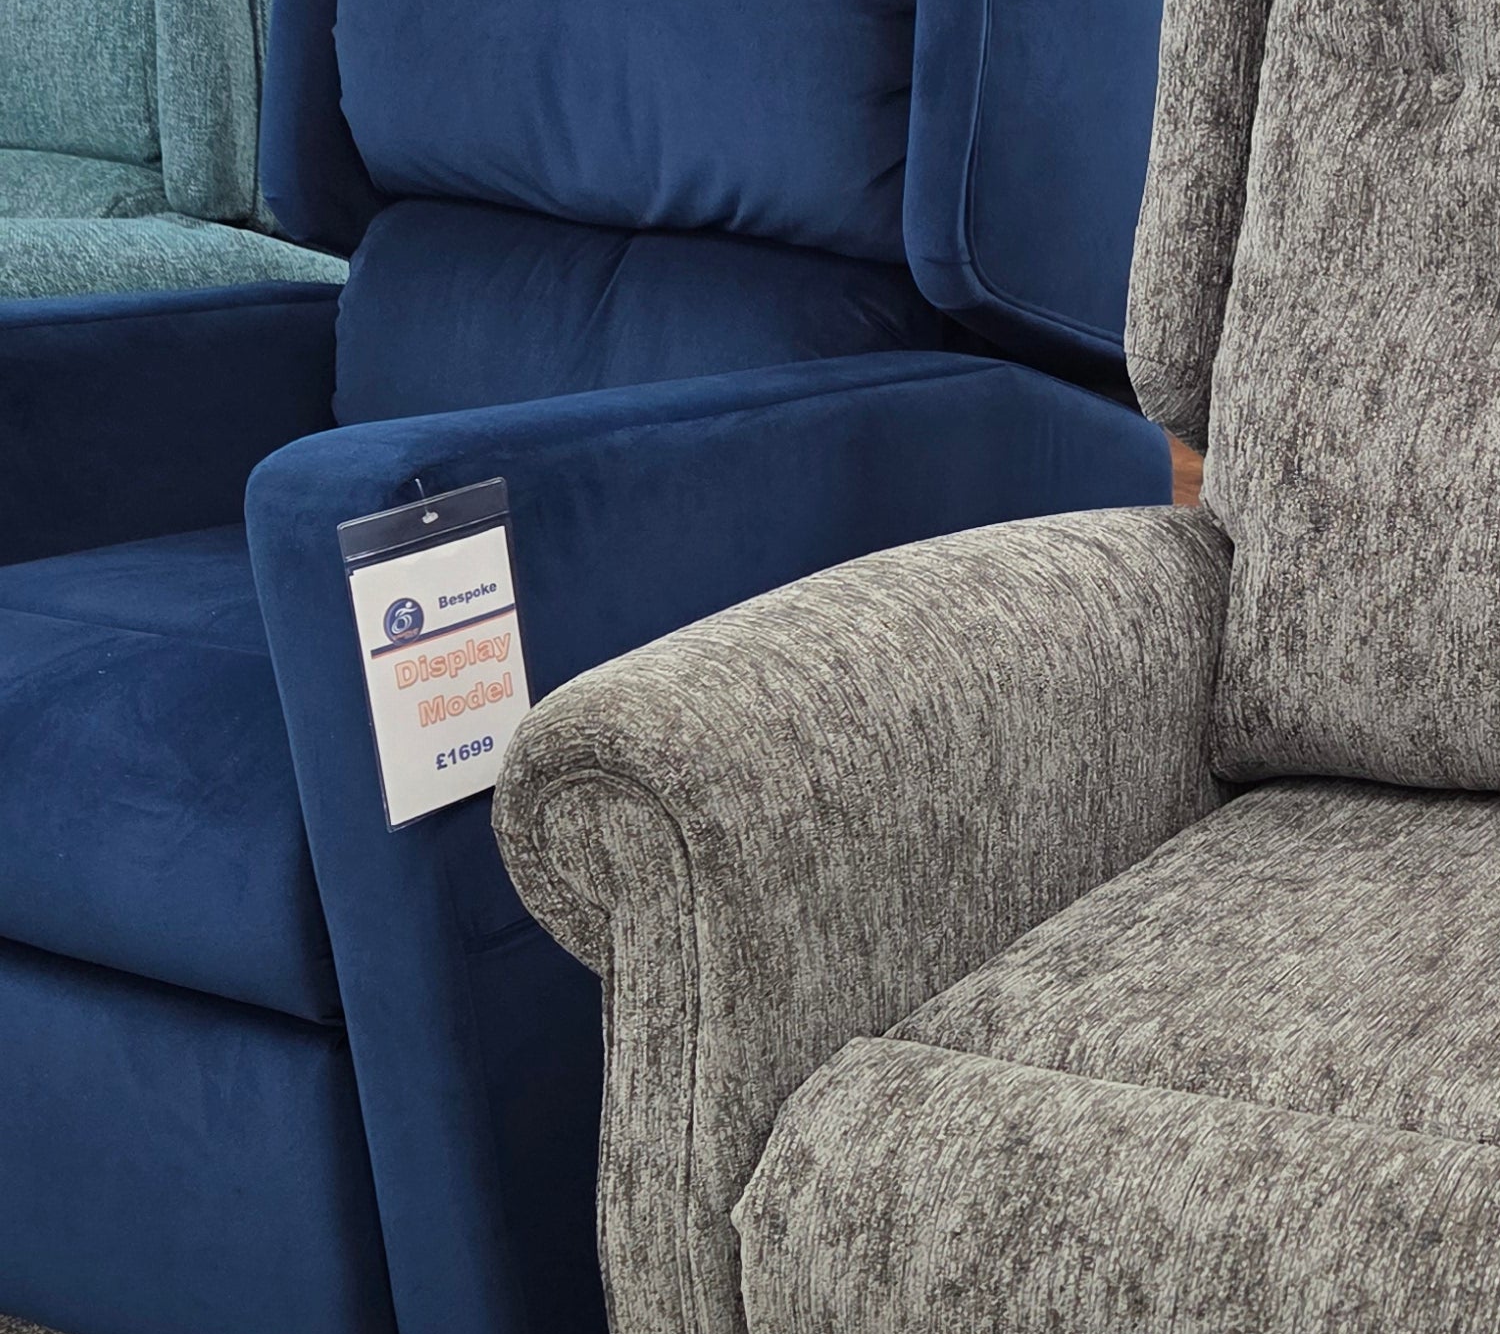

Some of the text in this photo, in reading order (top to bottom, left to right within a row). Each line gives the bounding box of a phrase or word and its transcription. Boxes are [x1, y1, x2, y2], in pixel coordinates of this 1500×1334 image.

[438, 581, 498, 610] Bespoke
[394, 632, 512, 690] Display
[417, 672, 514, 728] Model
[435, 735, 495, 771] £1699
